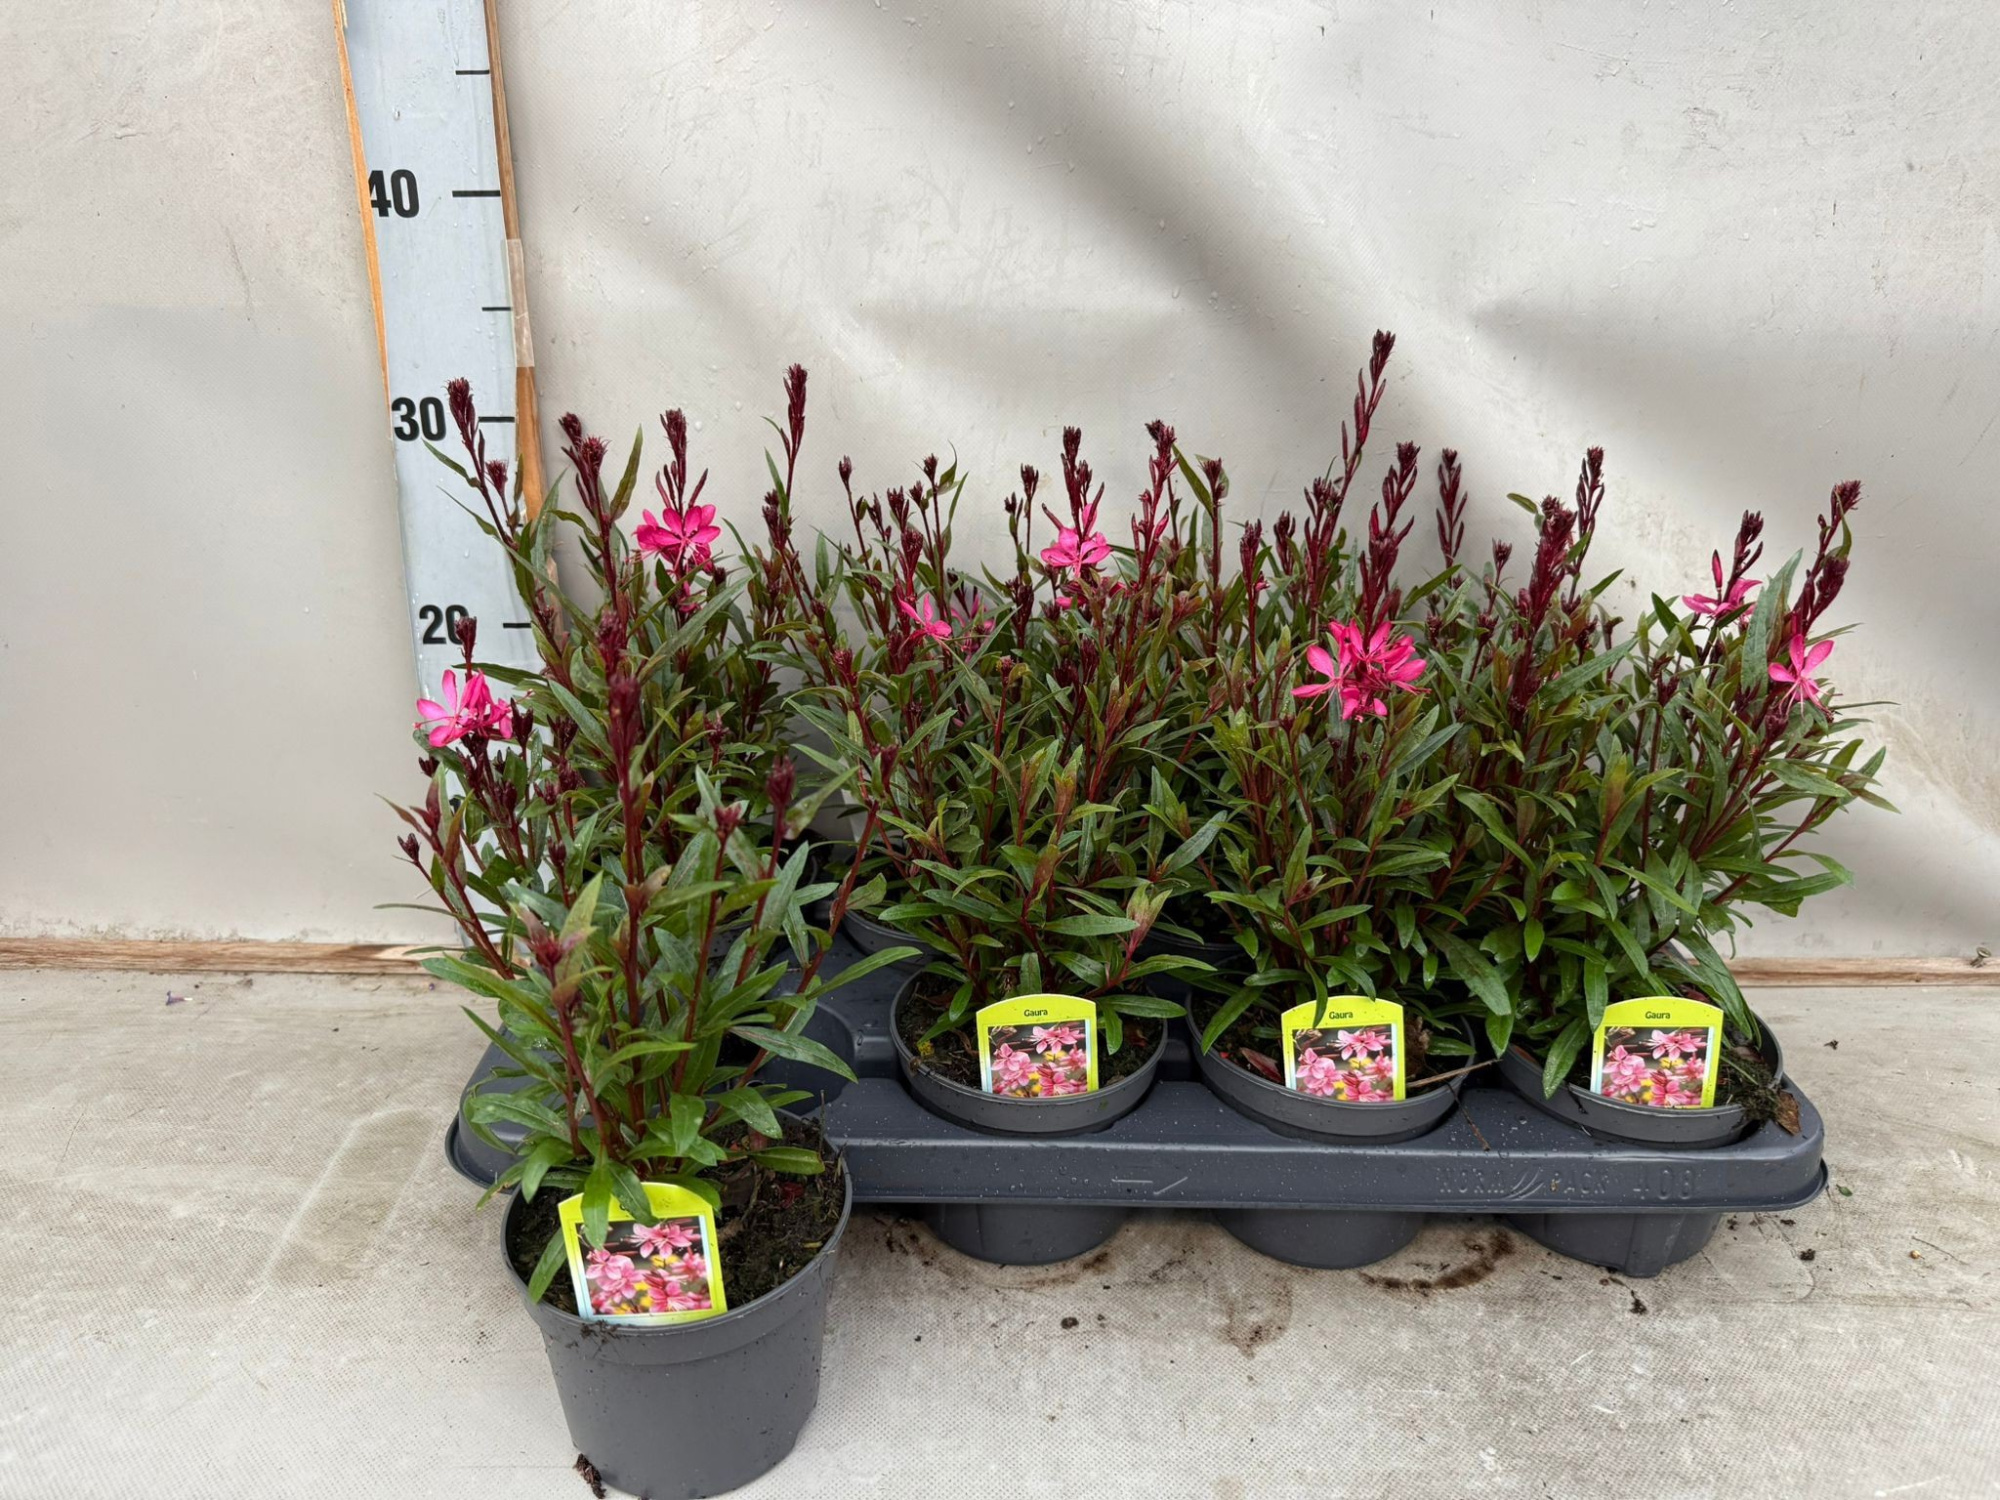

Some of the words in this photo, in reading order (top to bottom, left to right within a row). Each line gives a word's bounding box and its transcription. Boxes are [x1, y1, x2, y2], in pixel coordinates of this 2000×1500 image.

[368, 169, 419, 218] 40
[391, 396, 447, 441] 30
[419, 604, 470, 645] 20
[1023, 1009, 1048, 1017] Gaura
[1328, 1011, 1354, 1019] Gaura
[1645, 1011, 1671, 1019] Gaura
